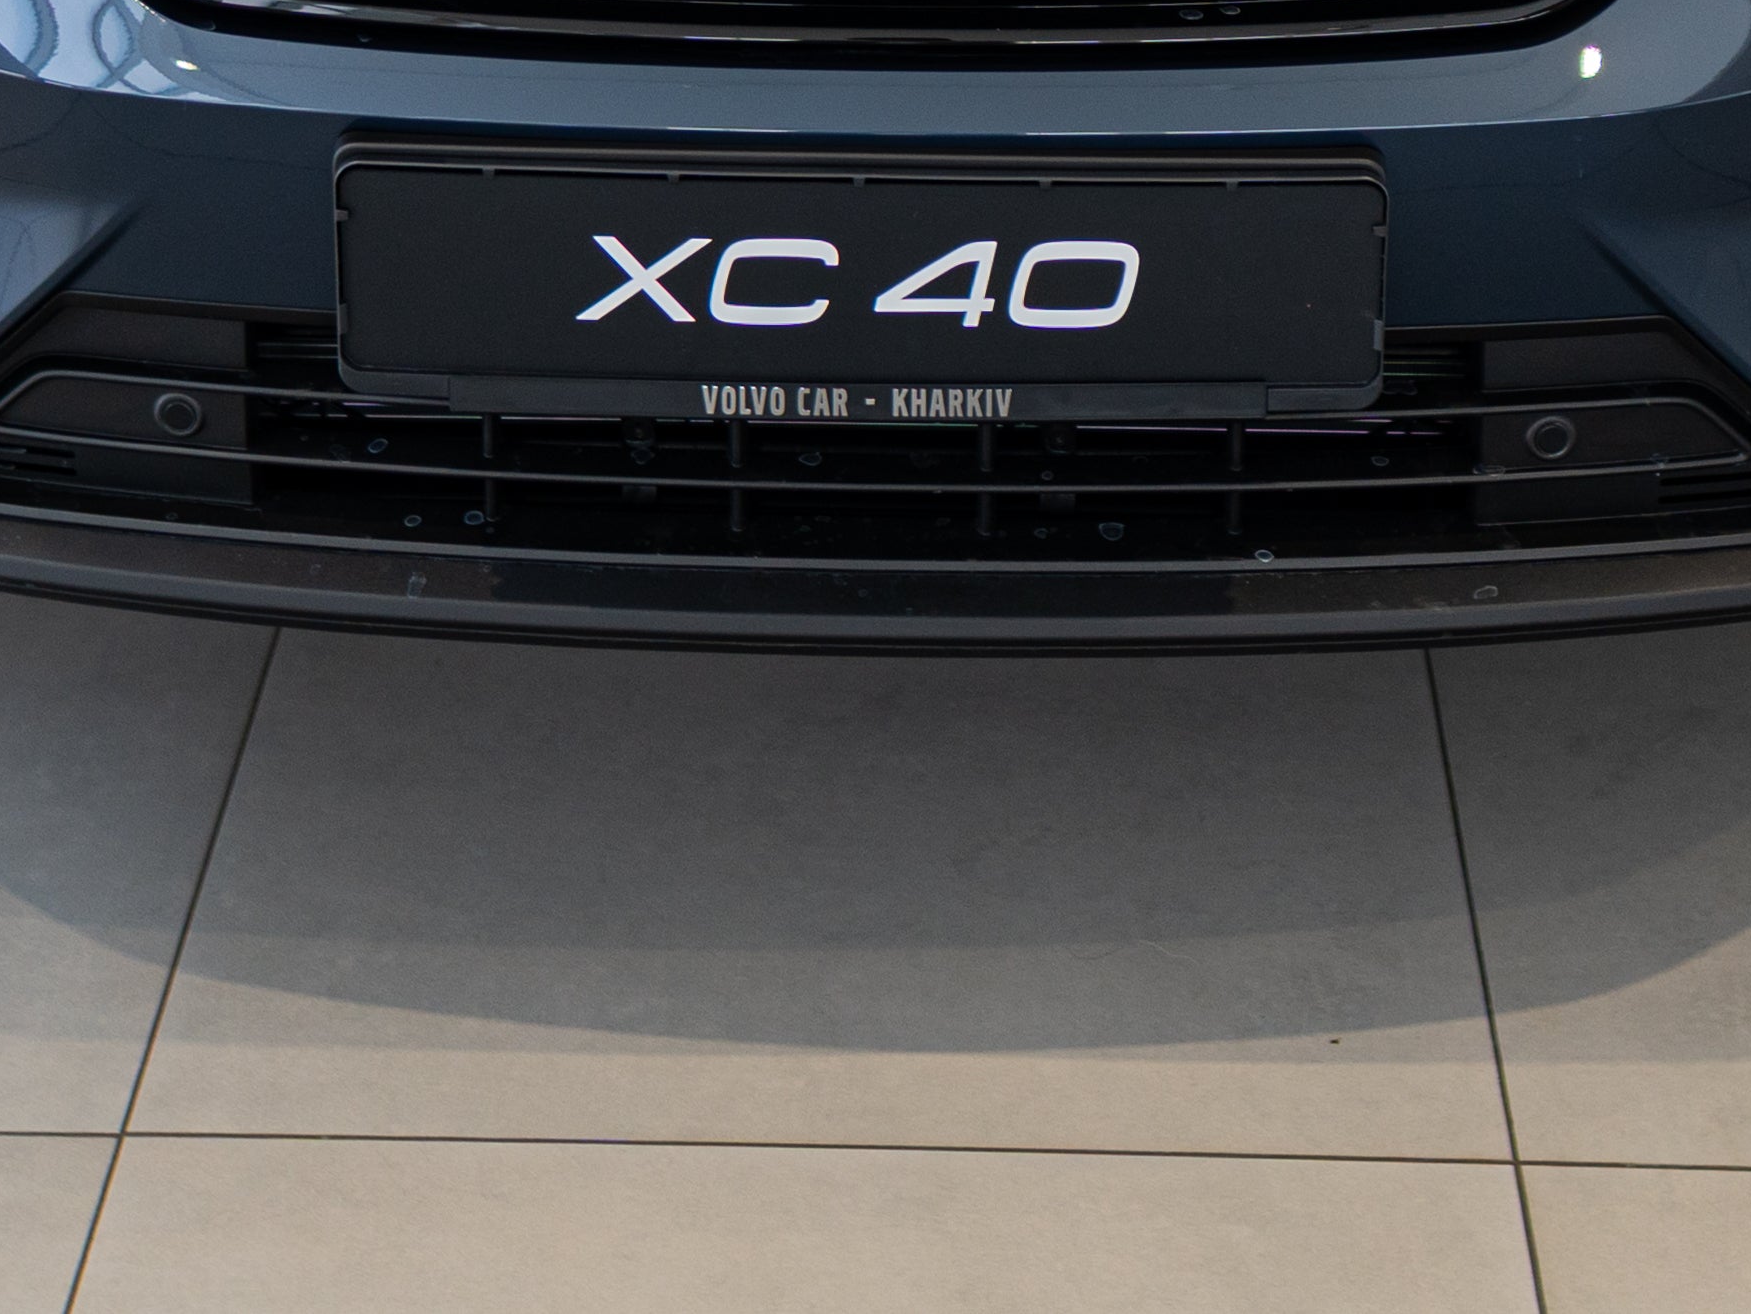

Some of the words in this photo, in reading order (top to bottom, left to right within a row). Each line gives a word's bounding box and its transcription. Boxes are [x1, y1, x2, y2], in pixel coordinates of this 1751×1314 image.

[575, 235, 840, 326] XC
[873, 240, 1140, 329] 40
[700, 384, 786, 417] VOLVO
[797, 385, 849, 418] CAR
[892, 387, 1013, 418] KHARKIV
